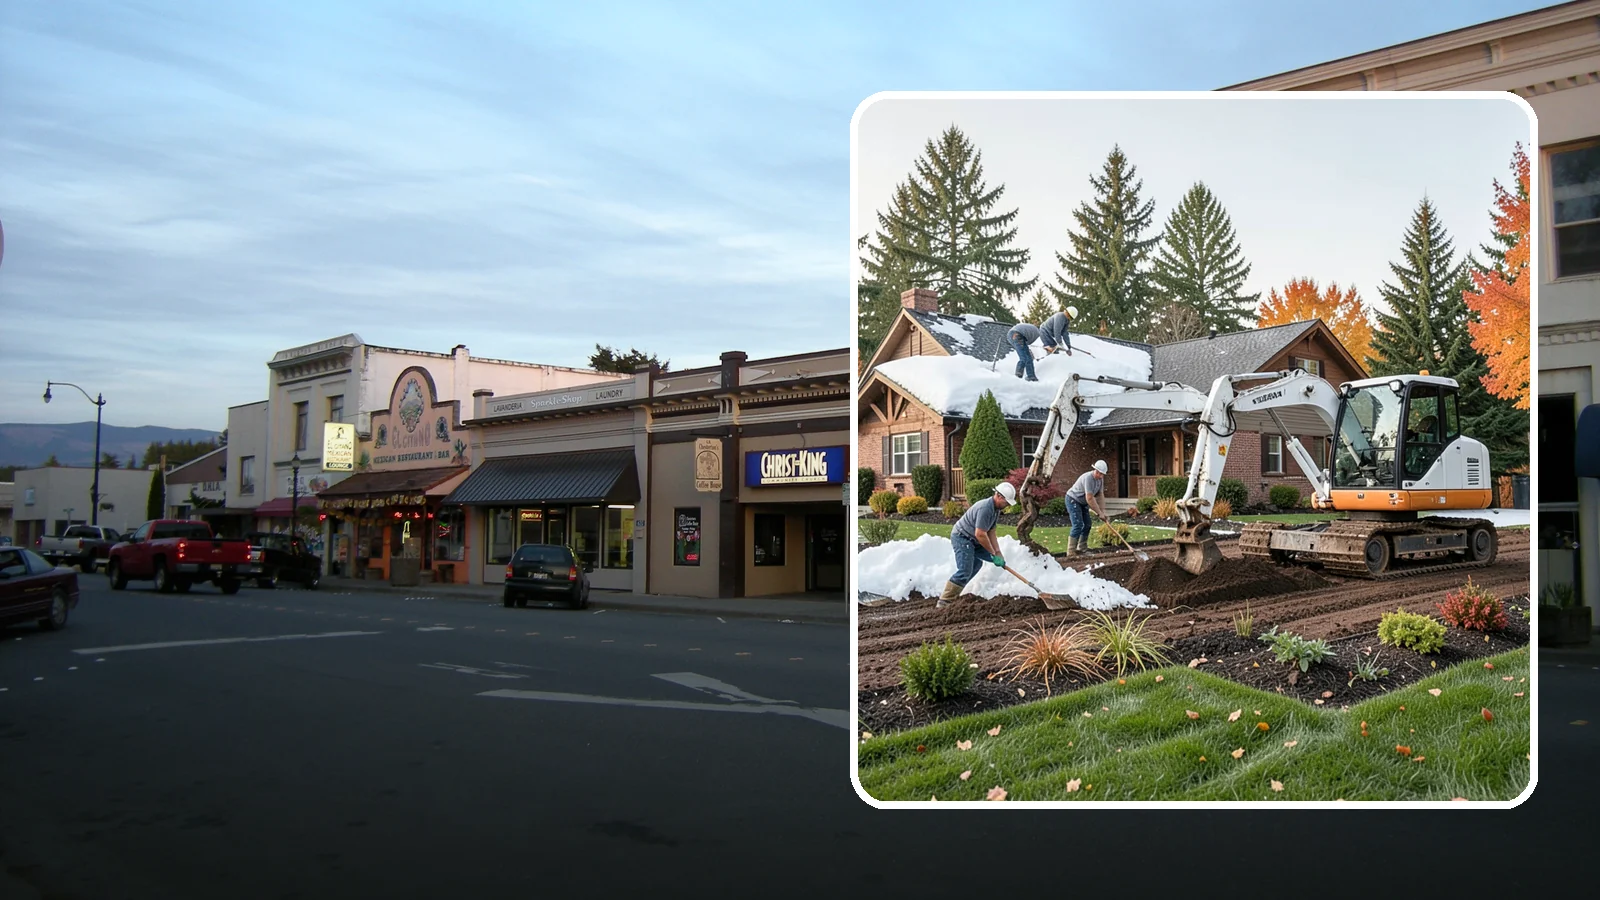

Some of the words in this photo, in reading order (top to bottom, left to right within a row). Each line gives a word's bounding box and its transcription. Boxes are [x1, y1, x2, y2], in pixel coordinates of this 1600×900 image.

[493, 402, 523, 412] LAVANDERIA
[595, 388, 624, 400] LAUNDRY
[373, 454, 396, 464] MEXICAN
[397, 451, 434, 462] RESTAURANT
[437, 450, 450, 459] BAR
[760, 452, 797, 478] CHRIST
[799, 450, 827, 476] KING
